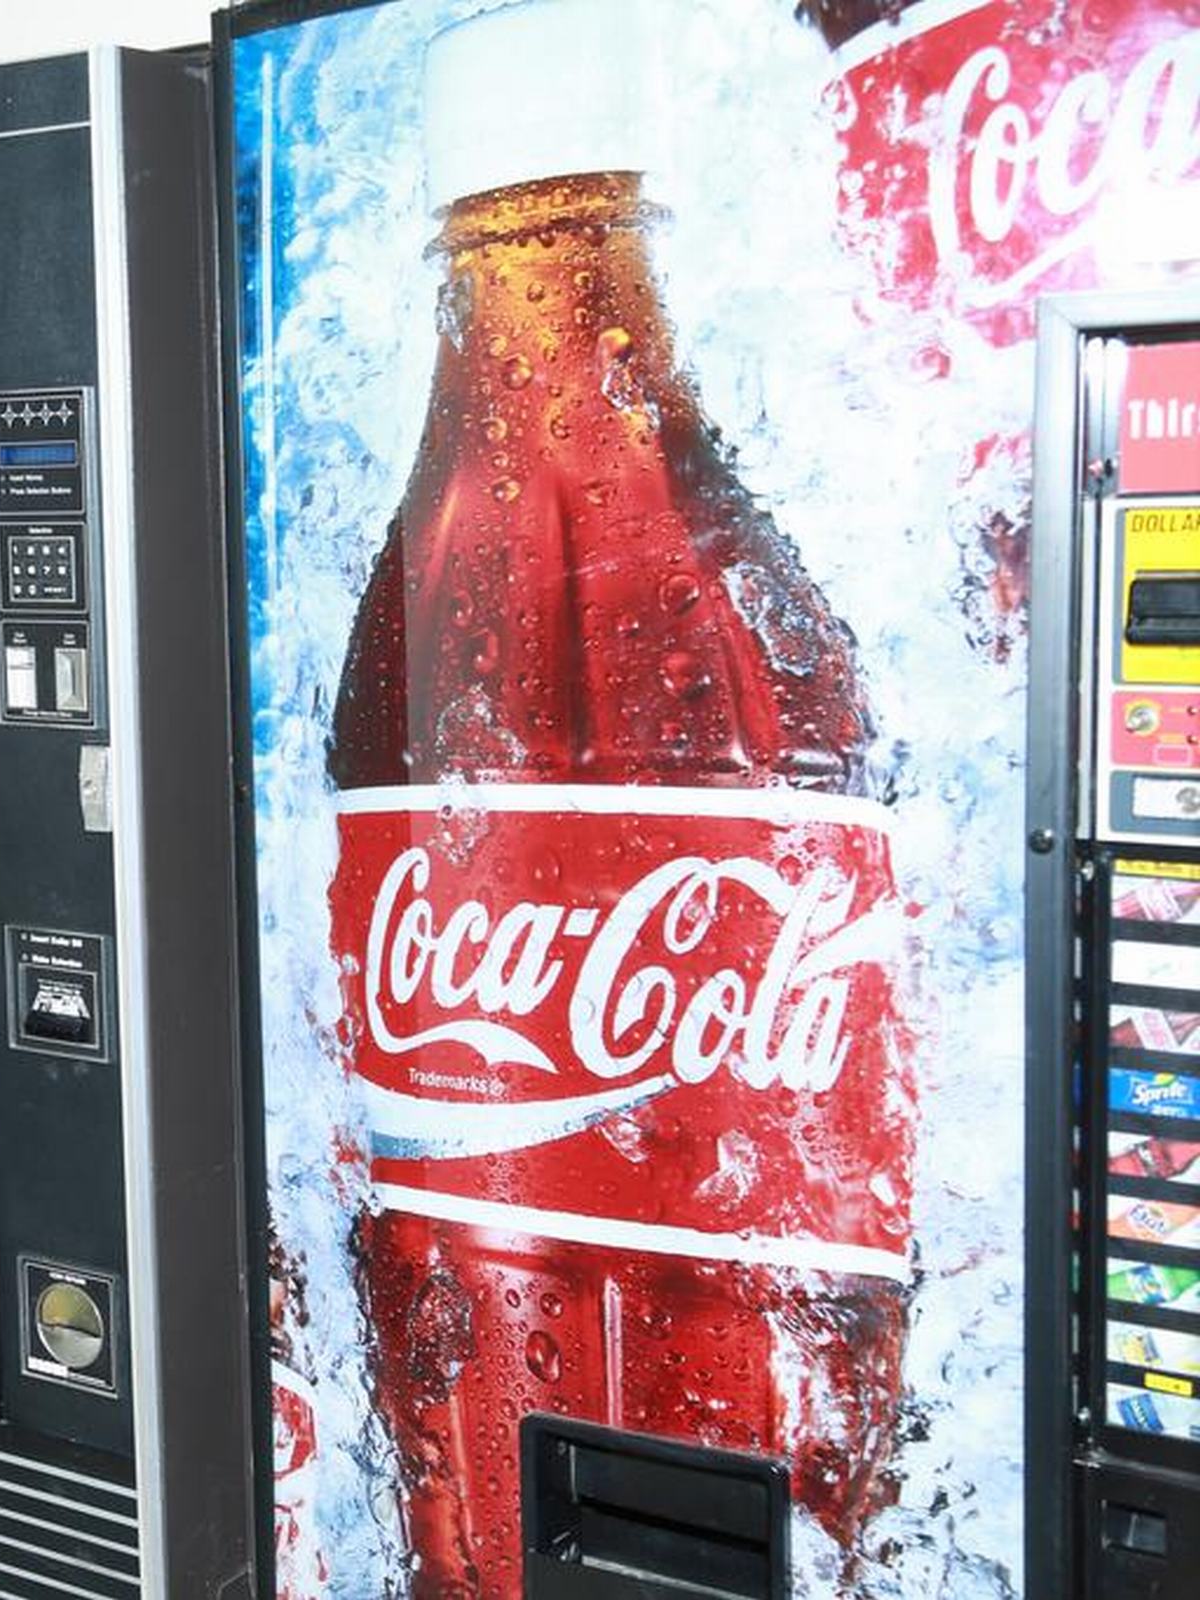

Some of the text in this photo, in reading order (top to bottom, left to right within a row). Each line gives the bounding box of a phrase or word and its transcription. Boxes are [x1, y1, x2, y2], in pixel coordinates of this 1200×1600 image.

[1128, 397, 1200, 440] Thir
[365, 846, 912, 1093] Coca-Cola
[1131, 1081, 1188, 1105] Sprite
